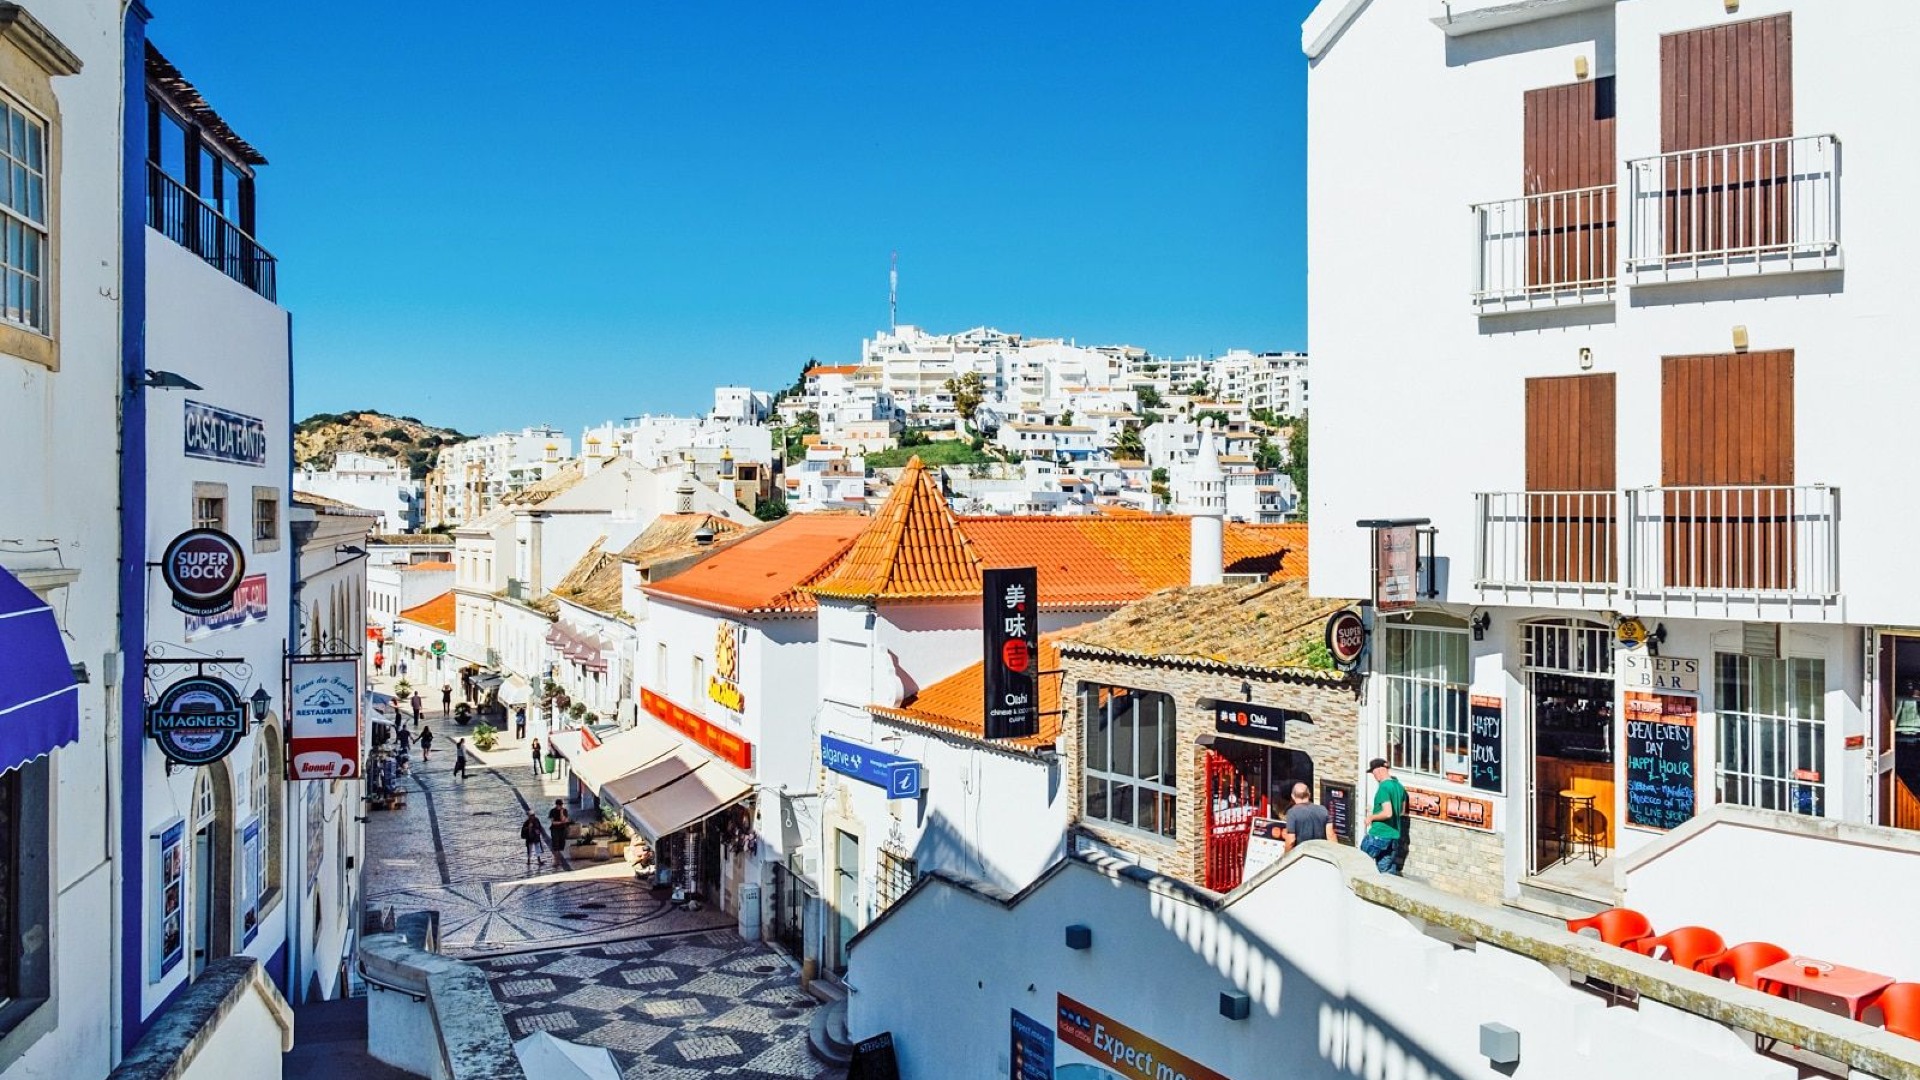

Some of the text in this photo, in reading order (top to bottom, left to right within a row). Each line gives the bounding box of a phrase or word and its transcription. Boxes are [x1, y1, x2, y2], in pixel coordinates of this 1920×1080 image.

[186, 412, 266, 459] CASA DA FONTE
[177, 551, 229, 566] SUPER
[179, 565, 226, 579] BOCK
[1338, 626, 1362, 638] SUPER
[1341, 636, 1362, 648] BOCK
[1626, 655, 1697, 673] STEPS
[1641, 672, 1682, 688] BAR
[1005, 693, 1028, 705] Oishi
[296, 707, 354, 717] RESTAURANTE
[158, 714, 236, 728] MAGNERS
[1471, 714, 1500, 738] HAPPY
[1627, 720, 1690, 751] OPEN EVERY
[822, 743, 850, 767] algarve
[1471, 743, 1500, 764] HOUR
[1645, 741, 1664, 758] DAY
[1628, 755, 1693, 779] HAPPY HOUR
[1093, 1022, 1153, 1076] Expect
